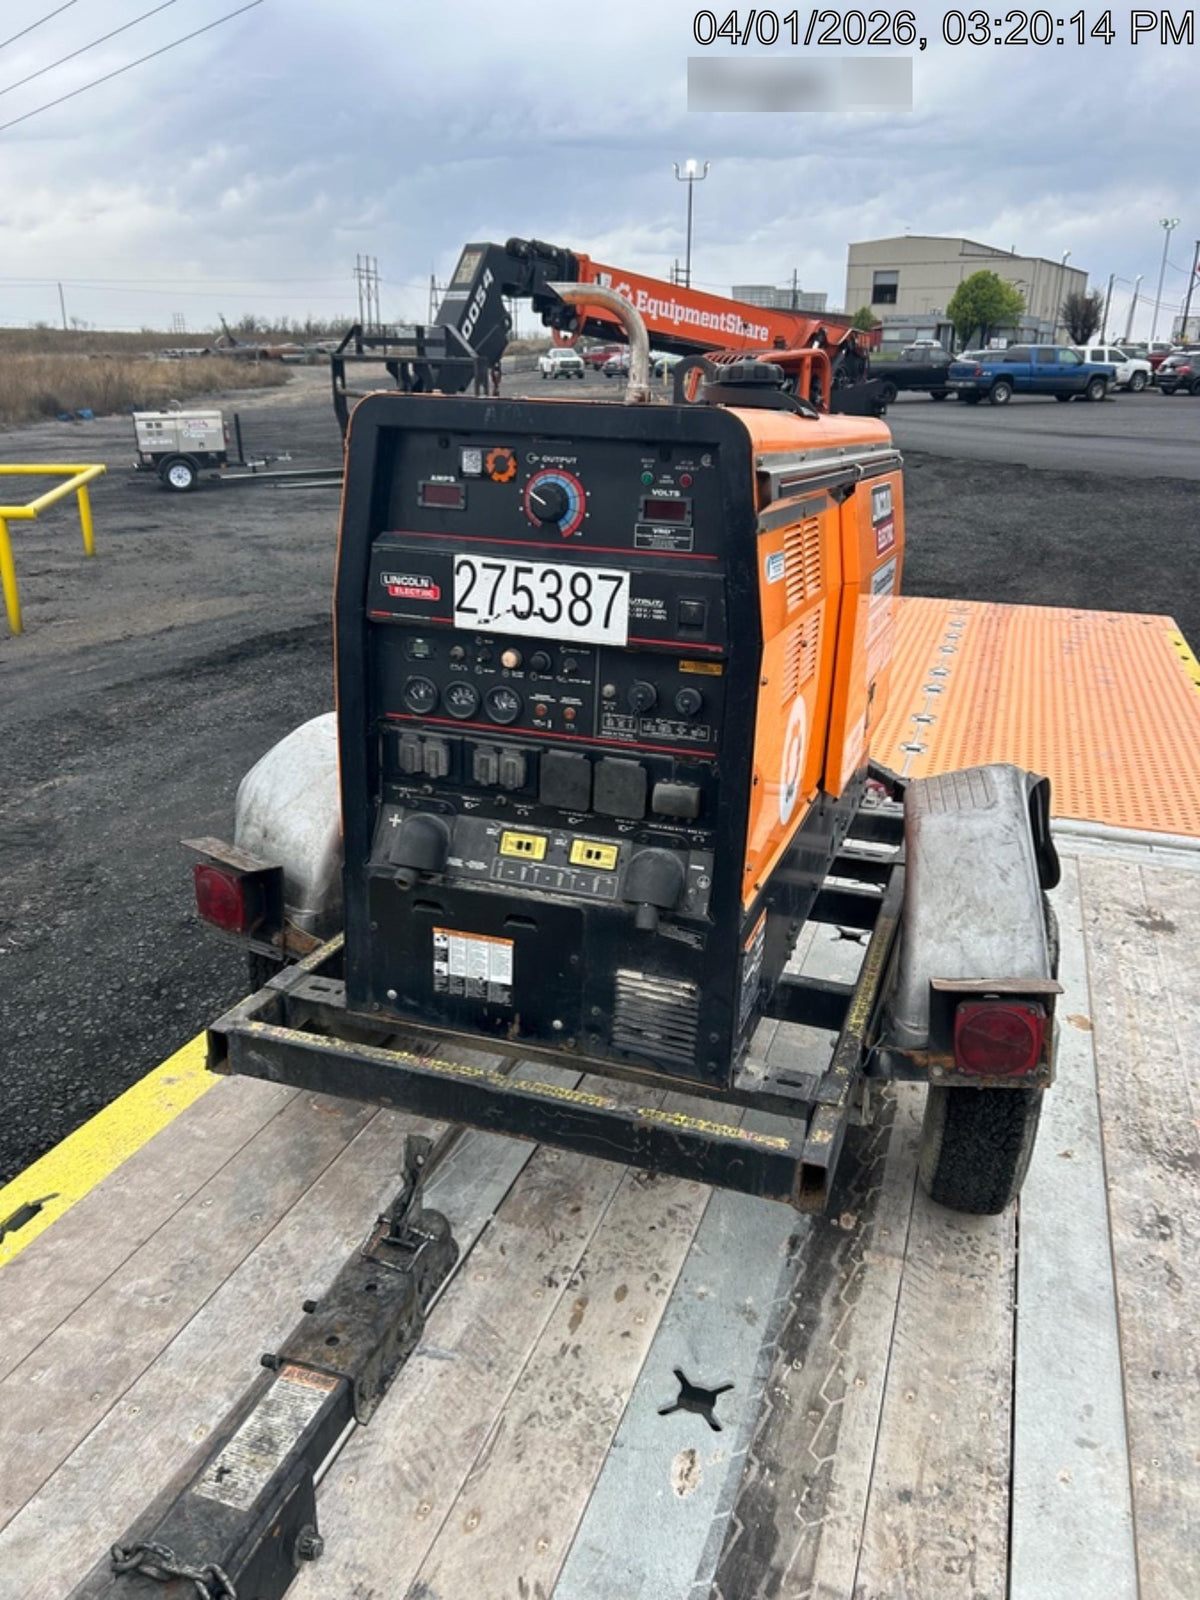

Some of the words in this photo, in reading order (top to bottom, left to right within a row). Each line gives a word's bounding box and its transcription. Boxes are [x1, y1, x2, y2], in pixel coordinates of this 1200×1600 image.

[636, 289, 769, 342] EquipmentShare
[541, 455, 577, 464] OUTPUT
[430, 474, 456, 483] AMPS
[651, 488, 681, 498] VOLTS
[383, 575, 430, 588] LINCOLN
[394, 587, 435, 598] ELECTRIC
[455, 559, 624, 629] 275387
